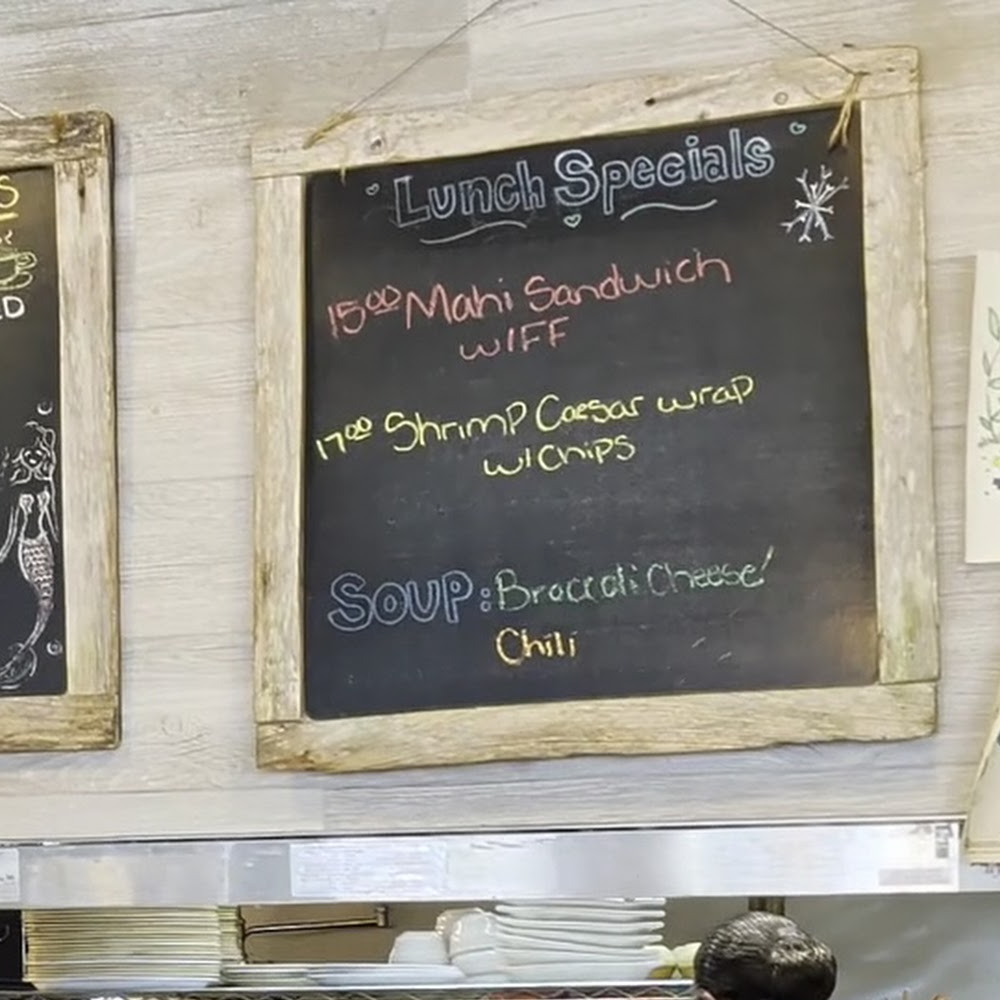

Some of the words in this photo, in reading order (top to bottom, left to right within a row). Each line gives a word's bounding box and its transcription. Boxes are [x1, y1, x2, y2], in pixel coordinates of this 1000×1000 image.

[393, 160, 546, 227] Lunch
[553, 129, 775, 214] Specials
[402, 278, 514, 329] Mahi
[522, 249, 733, 312] Sandwich
[535, 394, 644, 434] Caesar
[496, 626, 579, 665] Chili
